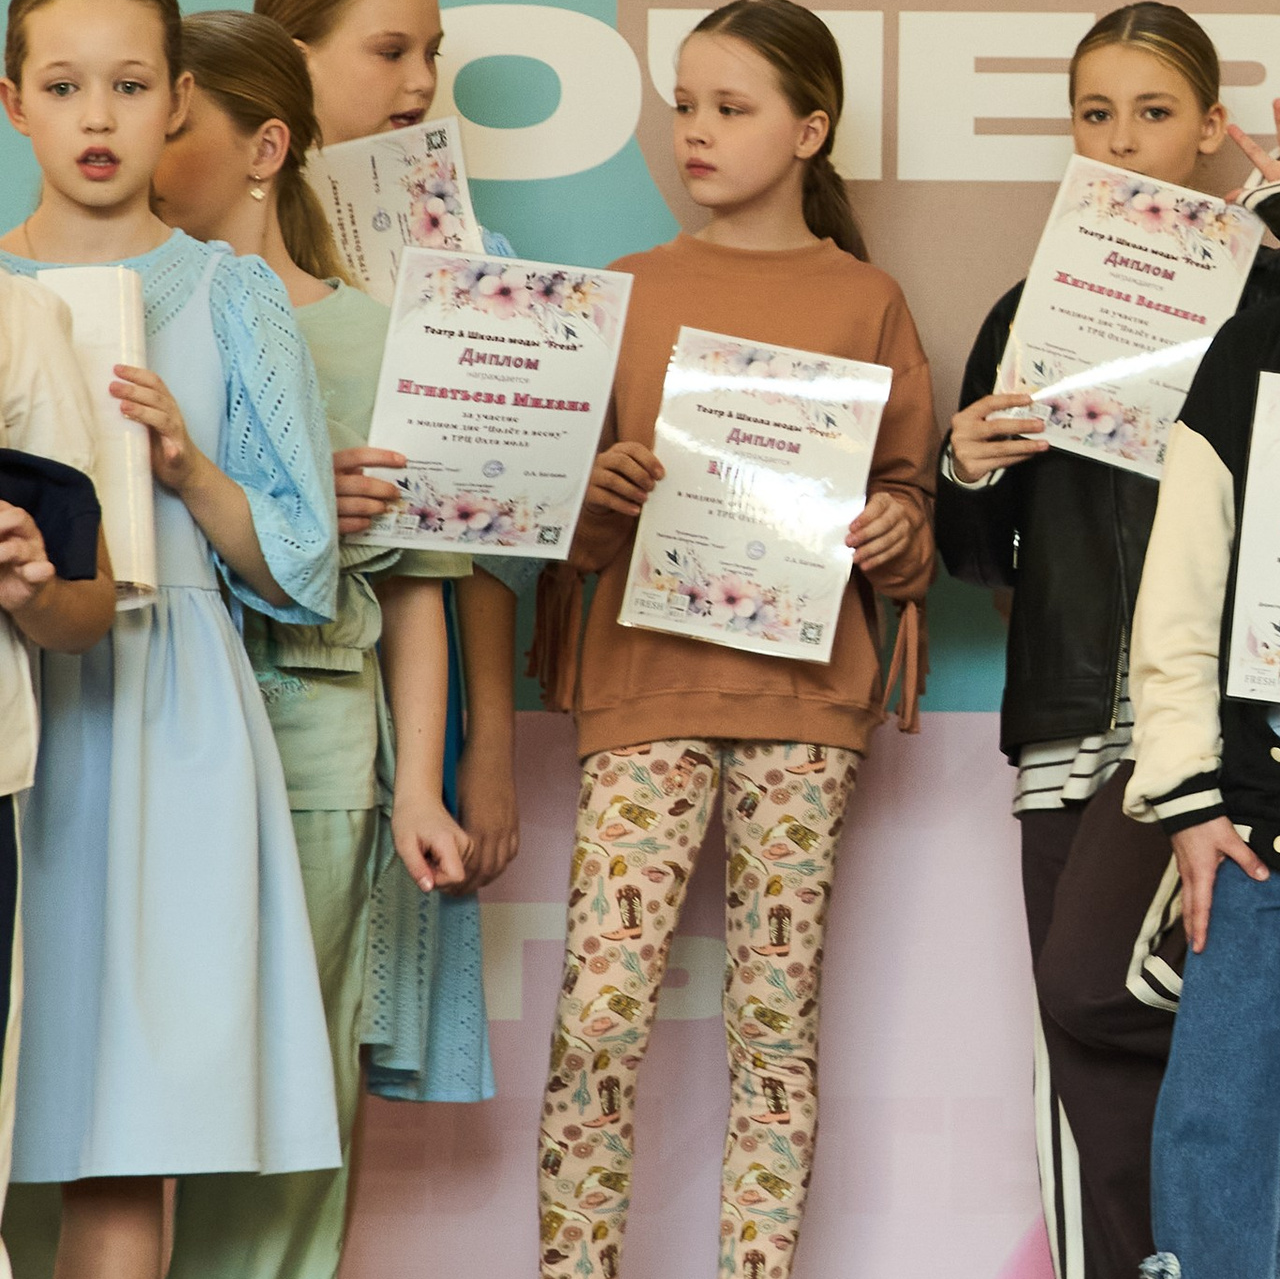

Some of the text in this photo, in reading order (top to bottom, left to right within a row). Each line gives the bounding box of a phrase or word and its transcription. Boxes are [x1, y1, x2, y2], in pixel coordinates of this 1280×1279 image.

[1103, 250, 1176, 282] Диплом
[467, 331, 505, 343] Школа
[458, 347, 541, 371] Диплом
[396, 378, 591, 413] Игнатьева Милана
[736, 412, 771, 426] Школа
[725, 427, 802, 455] Диплом
